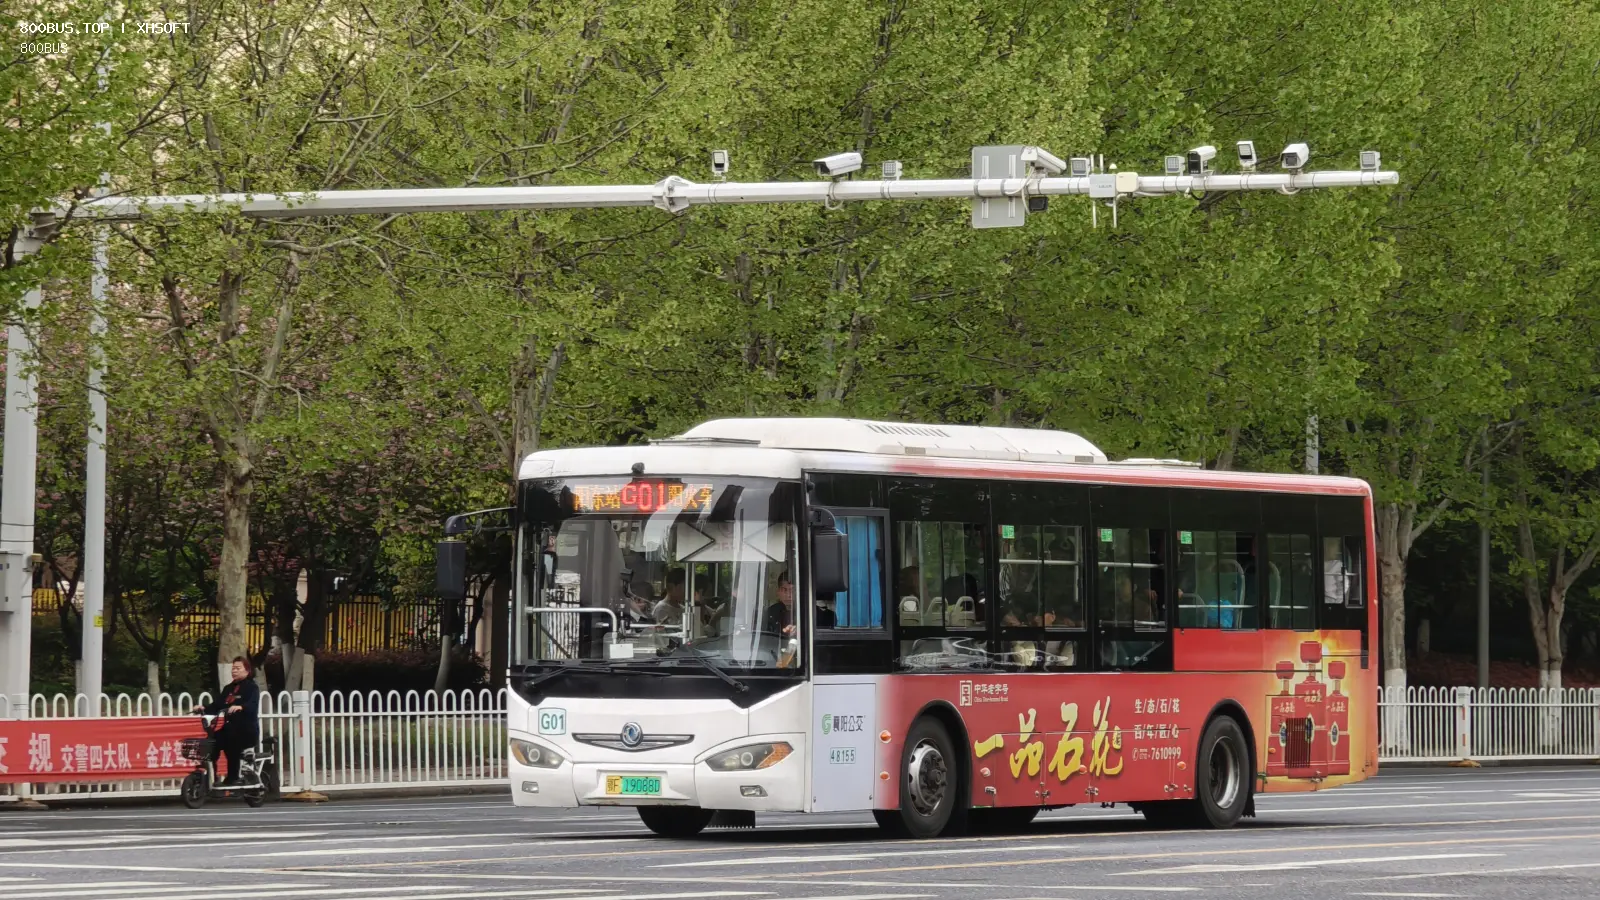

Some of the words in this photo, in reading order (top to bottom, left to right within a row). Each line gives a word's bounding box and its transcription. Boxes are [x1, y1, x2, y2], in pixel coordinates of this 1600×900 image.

[622, 482, 667, 512] G01
[974, 684, 1009, 695] 中华老字号
[540, 713, 565, 730] G01
[833, 715, 864, 732] 襄阳公交
[830, 749, 855, 762] 48155
